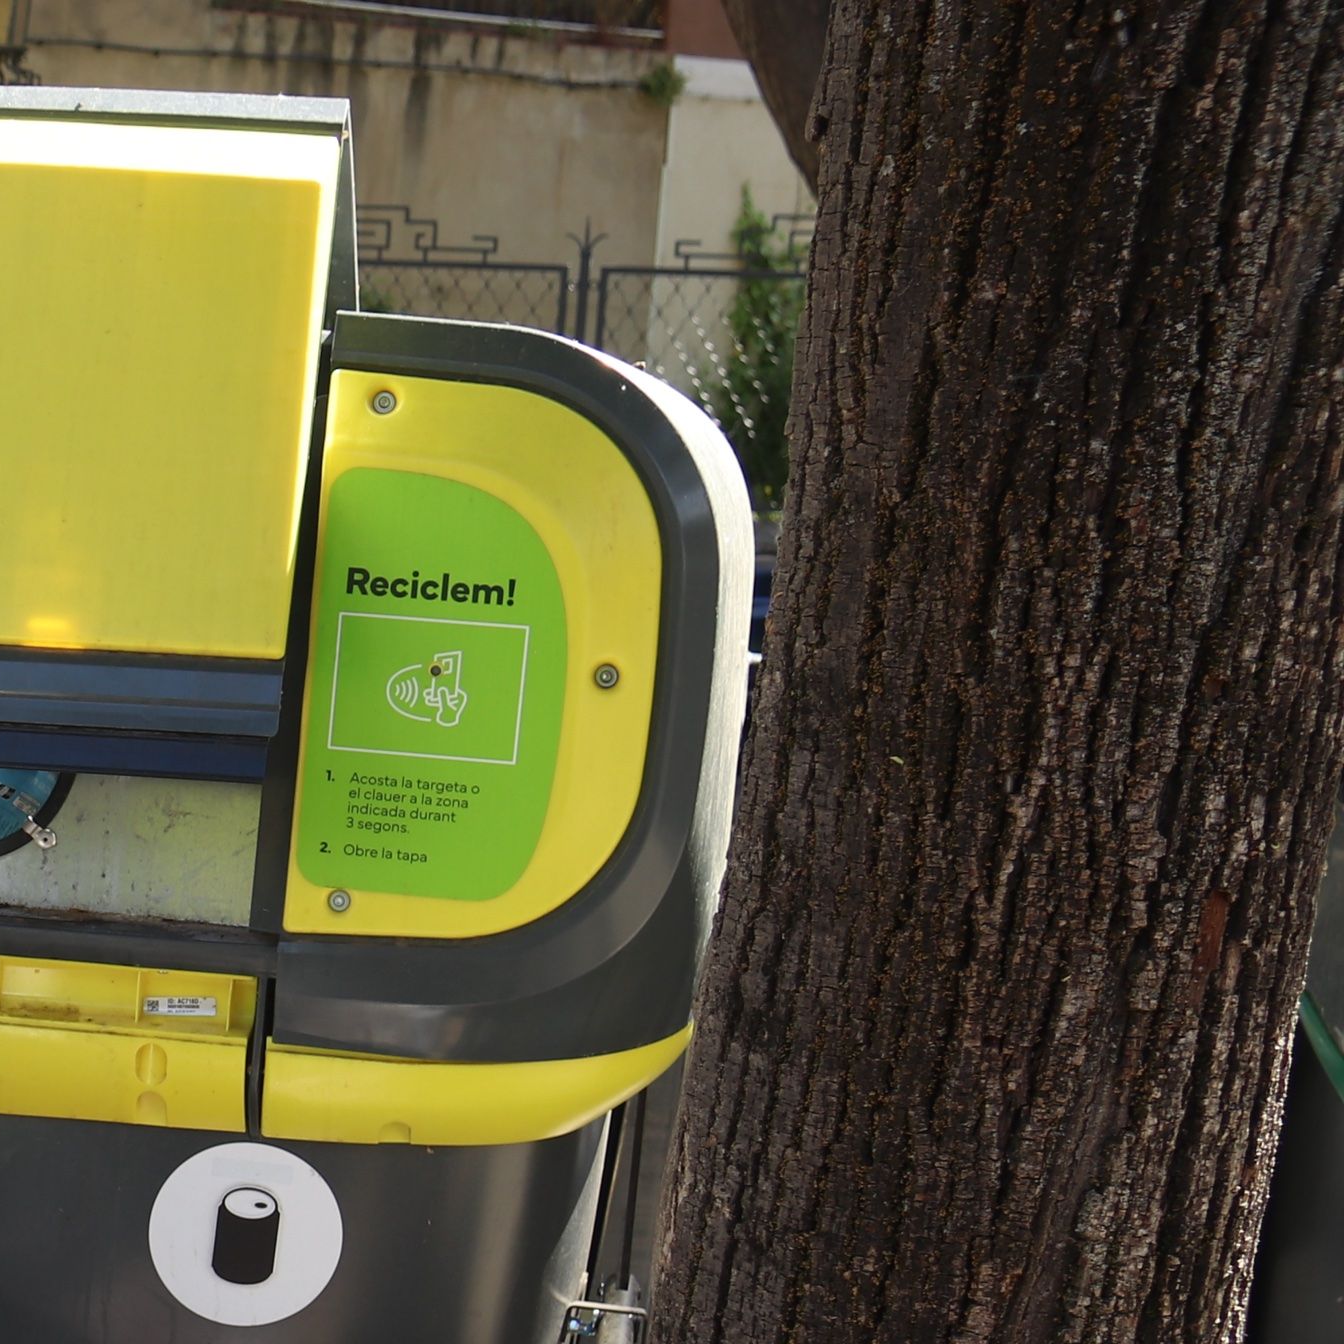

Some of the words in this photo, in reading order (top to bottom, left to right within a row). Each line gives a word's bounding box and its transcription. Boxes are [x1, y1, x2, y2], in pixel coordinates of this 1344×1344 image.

[346, 567, 517, 606] Reciclem!
[326, 769, 335, 782] 1.
[350, 772, 397, 788] Acosta
[401, 776, 412, 788] la
[416, 778, 467, 794] targeta
[471, 785, 480, 795] o
[348, 788, 360, 799] el
[363, 789, 406, 803] clauer
[409, 795, 417, 804] a
[421, 793, 432, 805] la
[436, 798, 469, 809] zona
[347, 801, 406, 818] indicada
[409, 808, 456, 823] durant
[346, 816, 354, 828] 3
[357, 820, 410, 834] segons.
[319, 842, 331, 854] 2.
[343, 843, 378, 858] Obre
[381, 847, 393, 859] la
[396, 849, 428, 864] tapa
